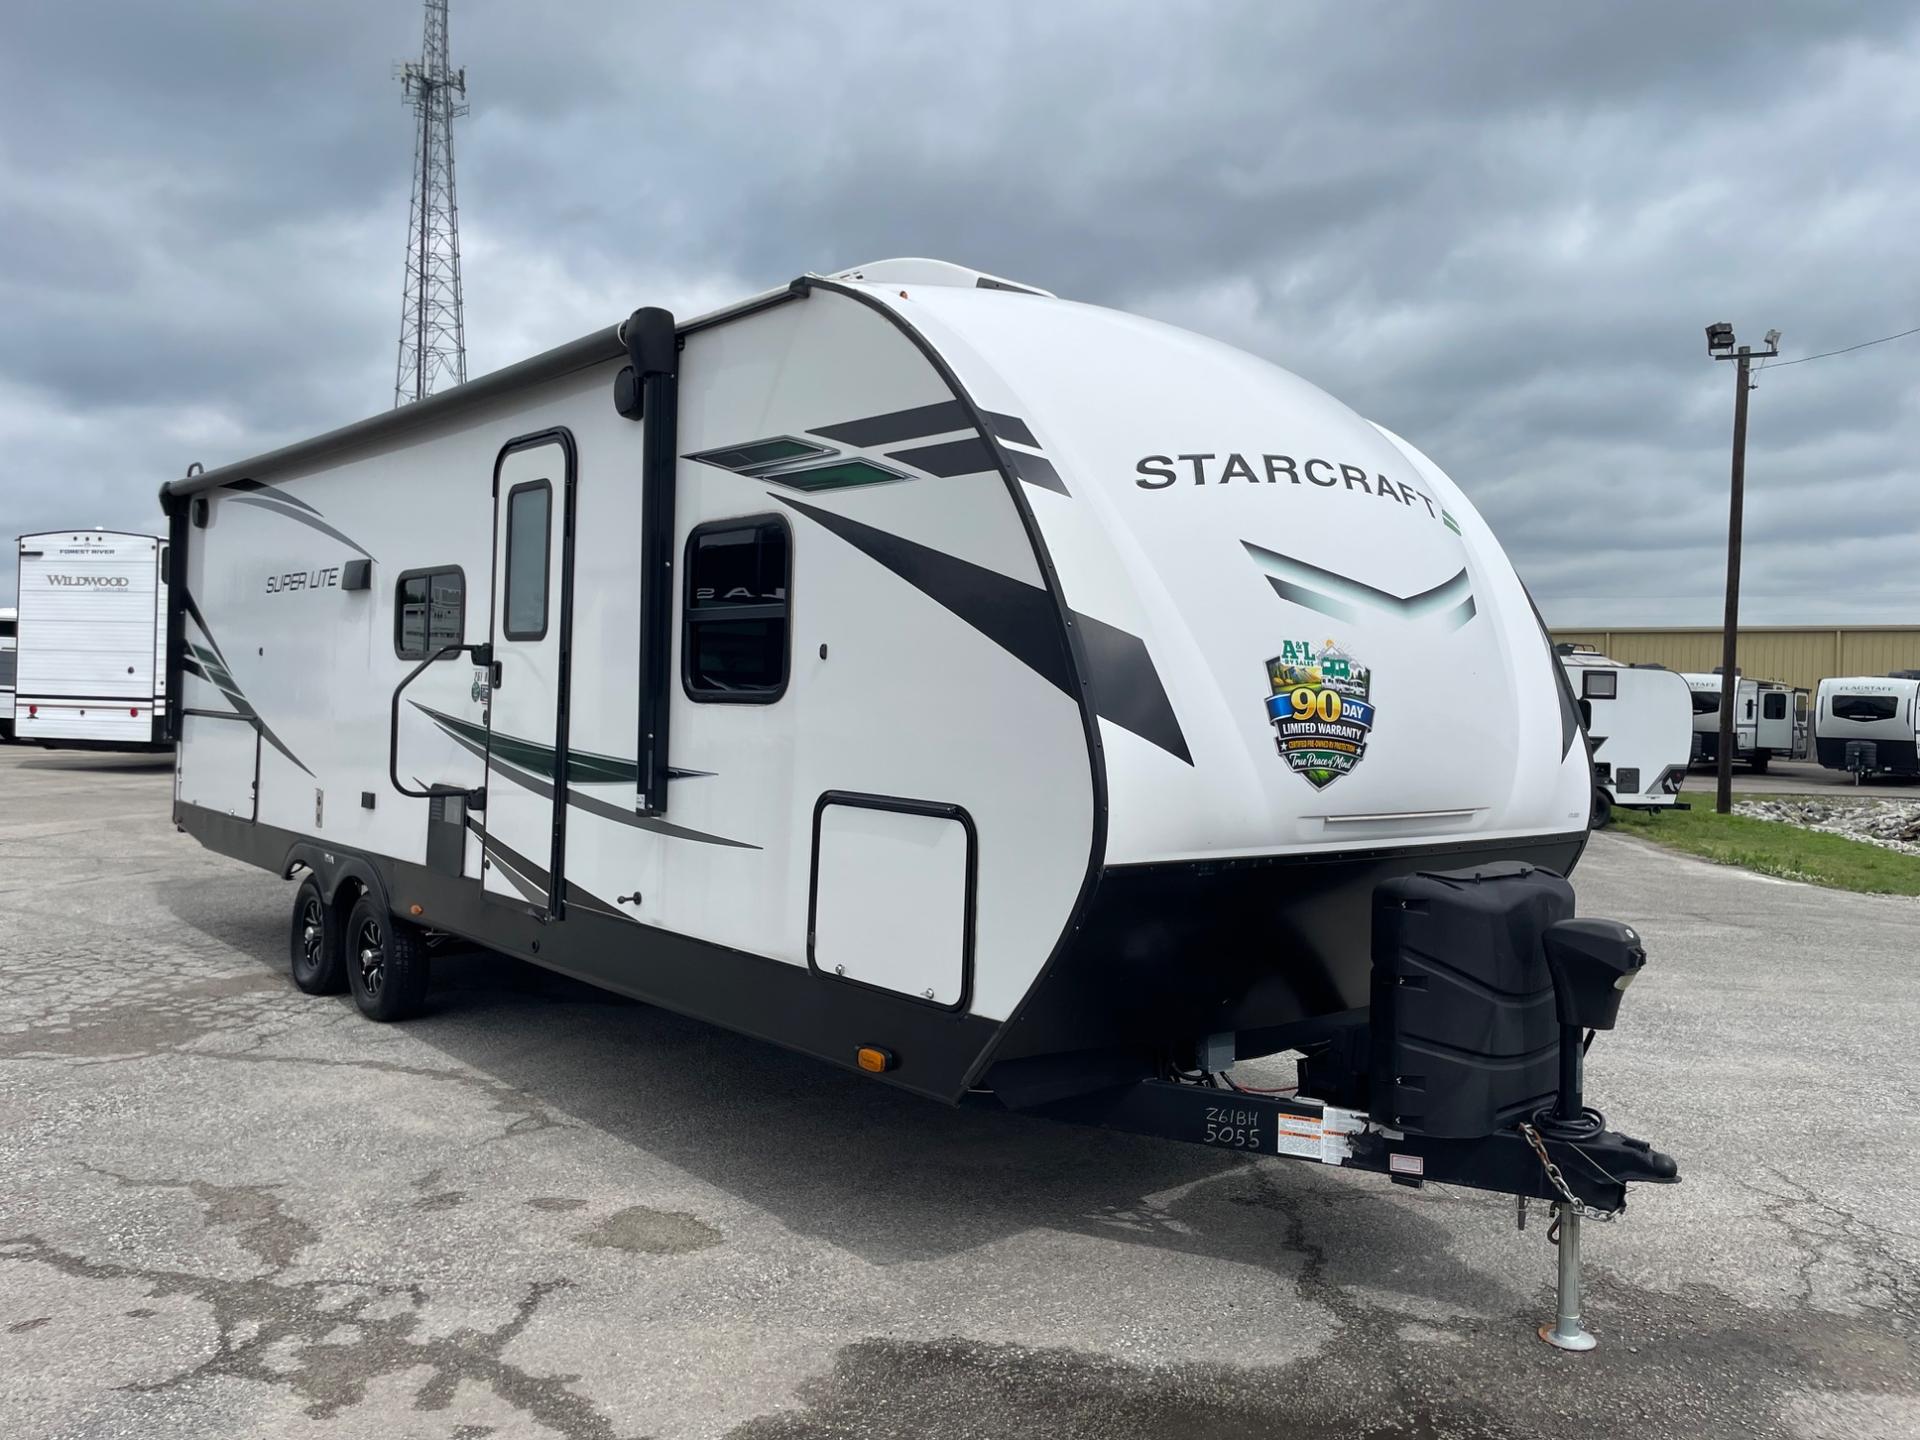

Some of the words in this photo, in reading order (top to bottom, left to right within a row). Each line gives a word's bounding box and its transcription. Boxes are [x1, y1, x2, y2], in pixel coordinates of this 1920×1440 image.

[1135, 453, 1436, 519] STARCRAFT
[47, 574, 129, 587] WILDWOOD
[266, 572, 307, 593] SUPER
[310, 567, 339, 589] LITE
[1281, 640, 1315, 661] A&L
[1290, 687, 1341, 723] 90
[1343, 703, 1364, 719] DAY
[1282, 722, 1316, 735] LIMITED
[1318, 722, 1361, 740] WARRANTY
[1289, 753, 1306, 767] True
[1307, 754, 1327, 768] Peace
[1333, 755, 1353, 769] Mind
[1203, 1123, 1261, 1148] 5055
